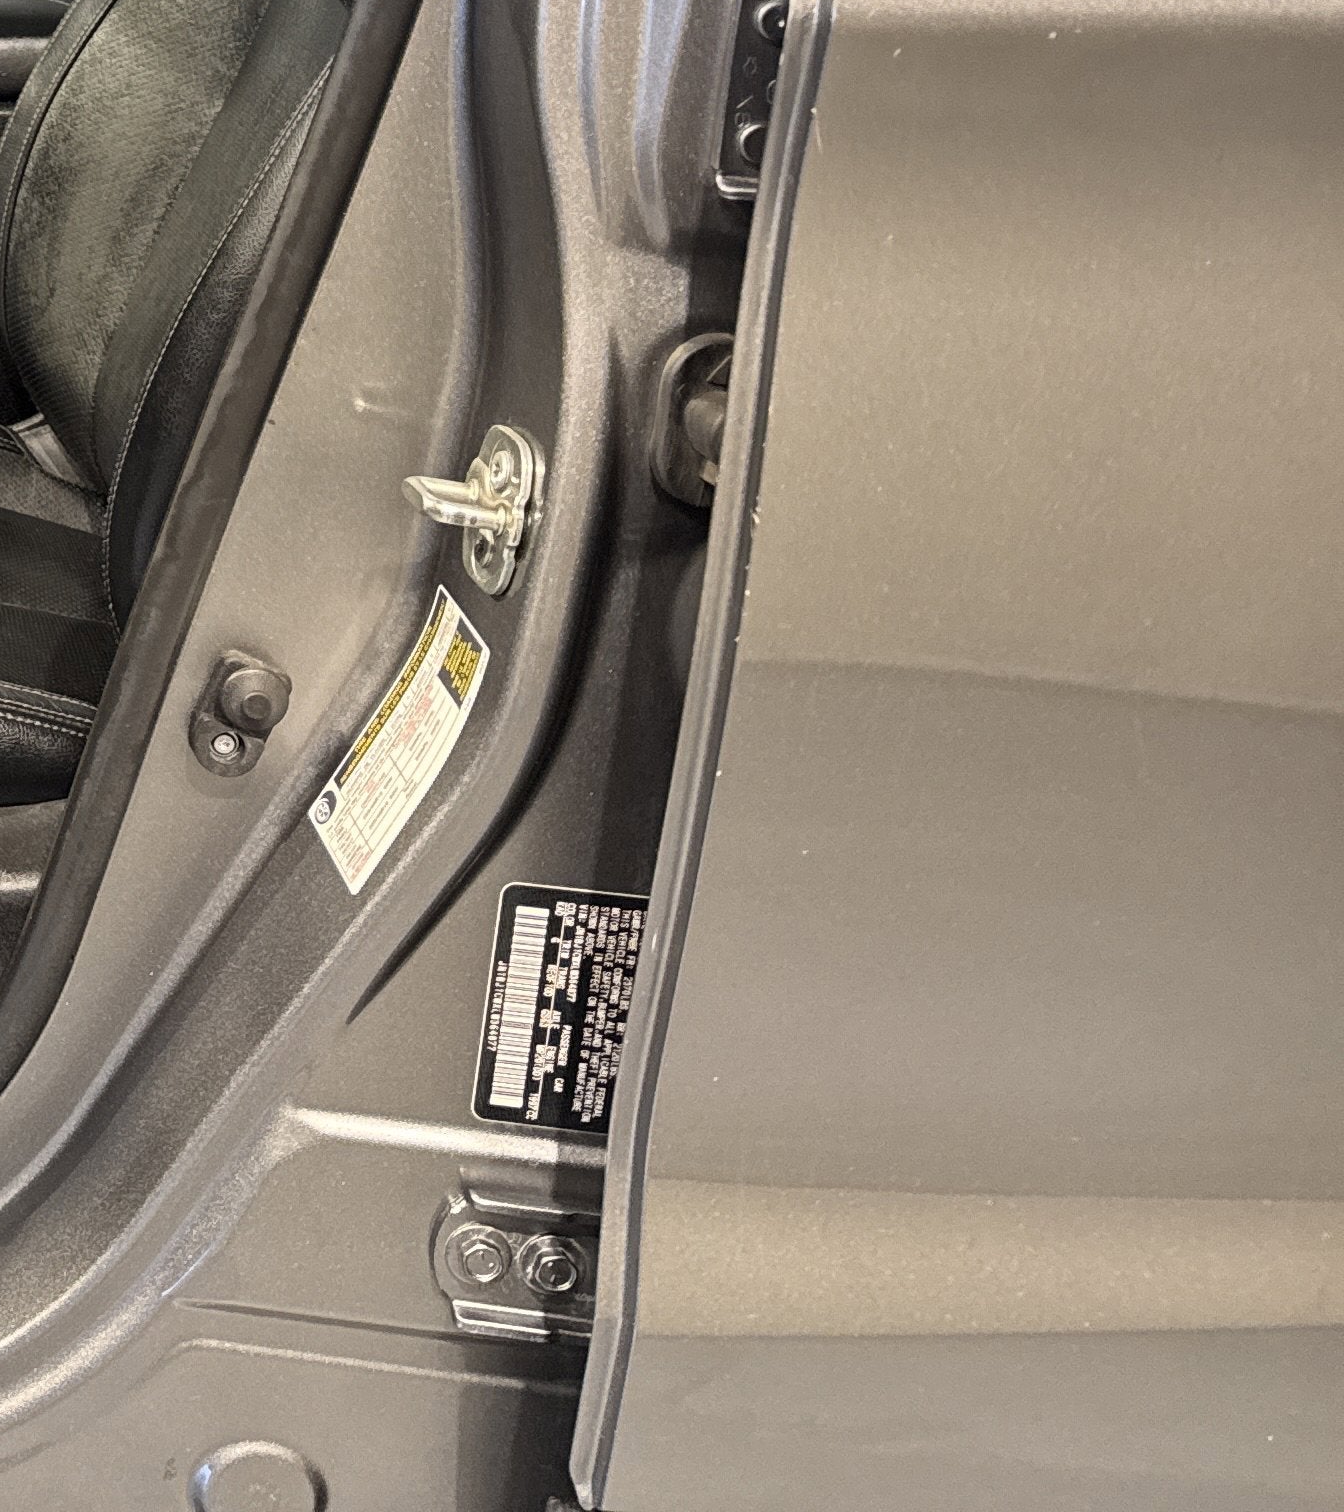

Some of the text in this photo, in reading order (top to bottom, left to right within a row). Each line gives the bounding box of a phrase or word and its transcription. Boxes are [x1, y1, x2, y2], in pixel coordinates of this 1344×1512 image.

[564, 903, 577, 926] COLOR
[587, 905, 599, 929] SHOWN
[609, 908, 621, 931] MOTOR
[560, 939, 572, 959] TRIM
[603, 935, 617, 967] VEHICLE
[555, 966, 568, 990] TRANS
[571, 906, 610, 1112] STANDARDS IN EFFECT ON THE DATE OF MANUFACTURE
[592, 909, 631, 1119] THIS VEHICLE CONFORMS TO ALL APPLICABLE FEDERAL
[557, 1025, 572, 1066] PASSENGER
[588, 1051, 601, 1073] THEFT
[553, 1078, 564, 1093] CAR
[580, 1077, 596, 1122] PREVENTION
